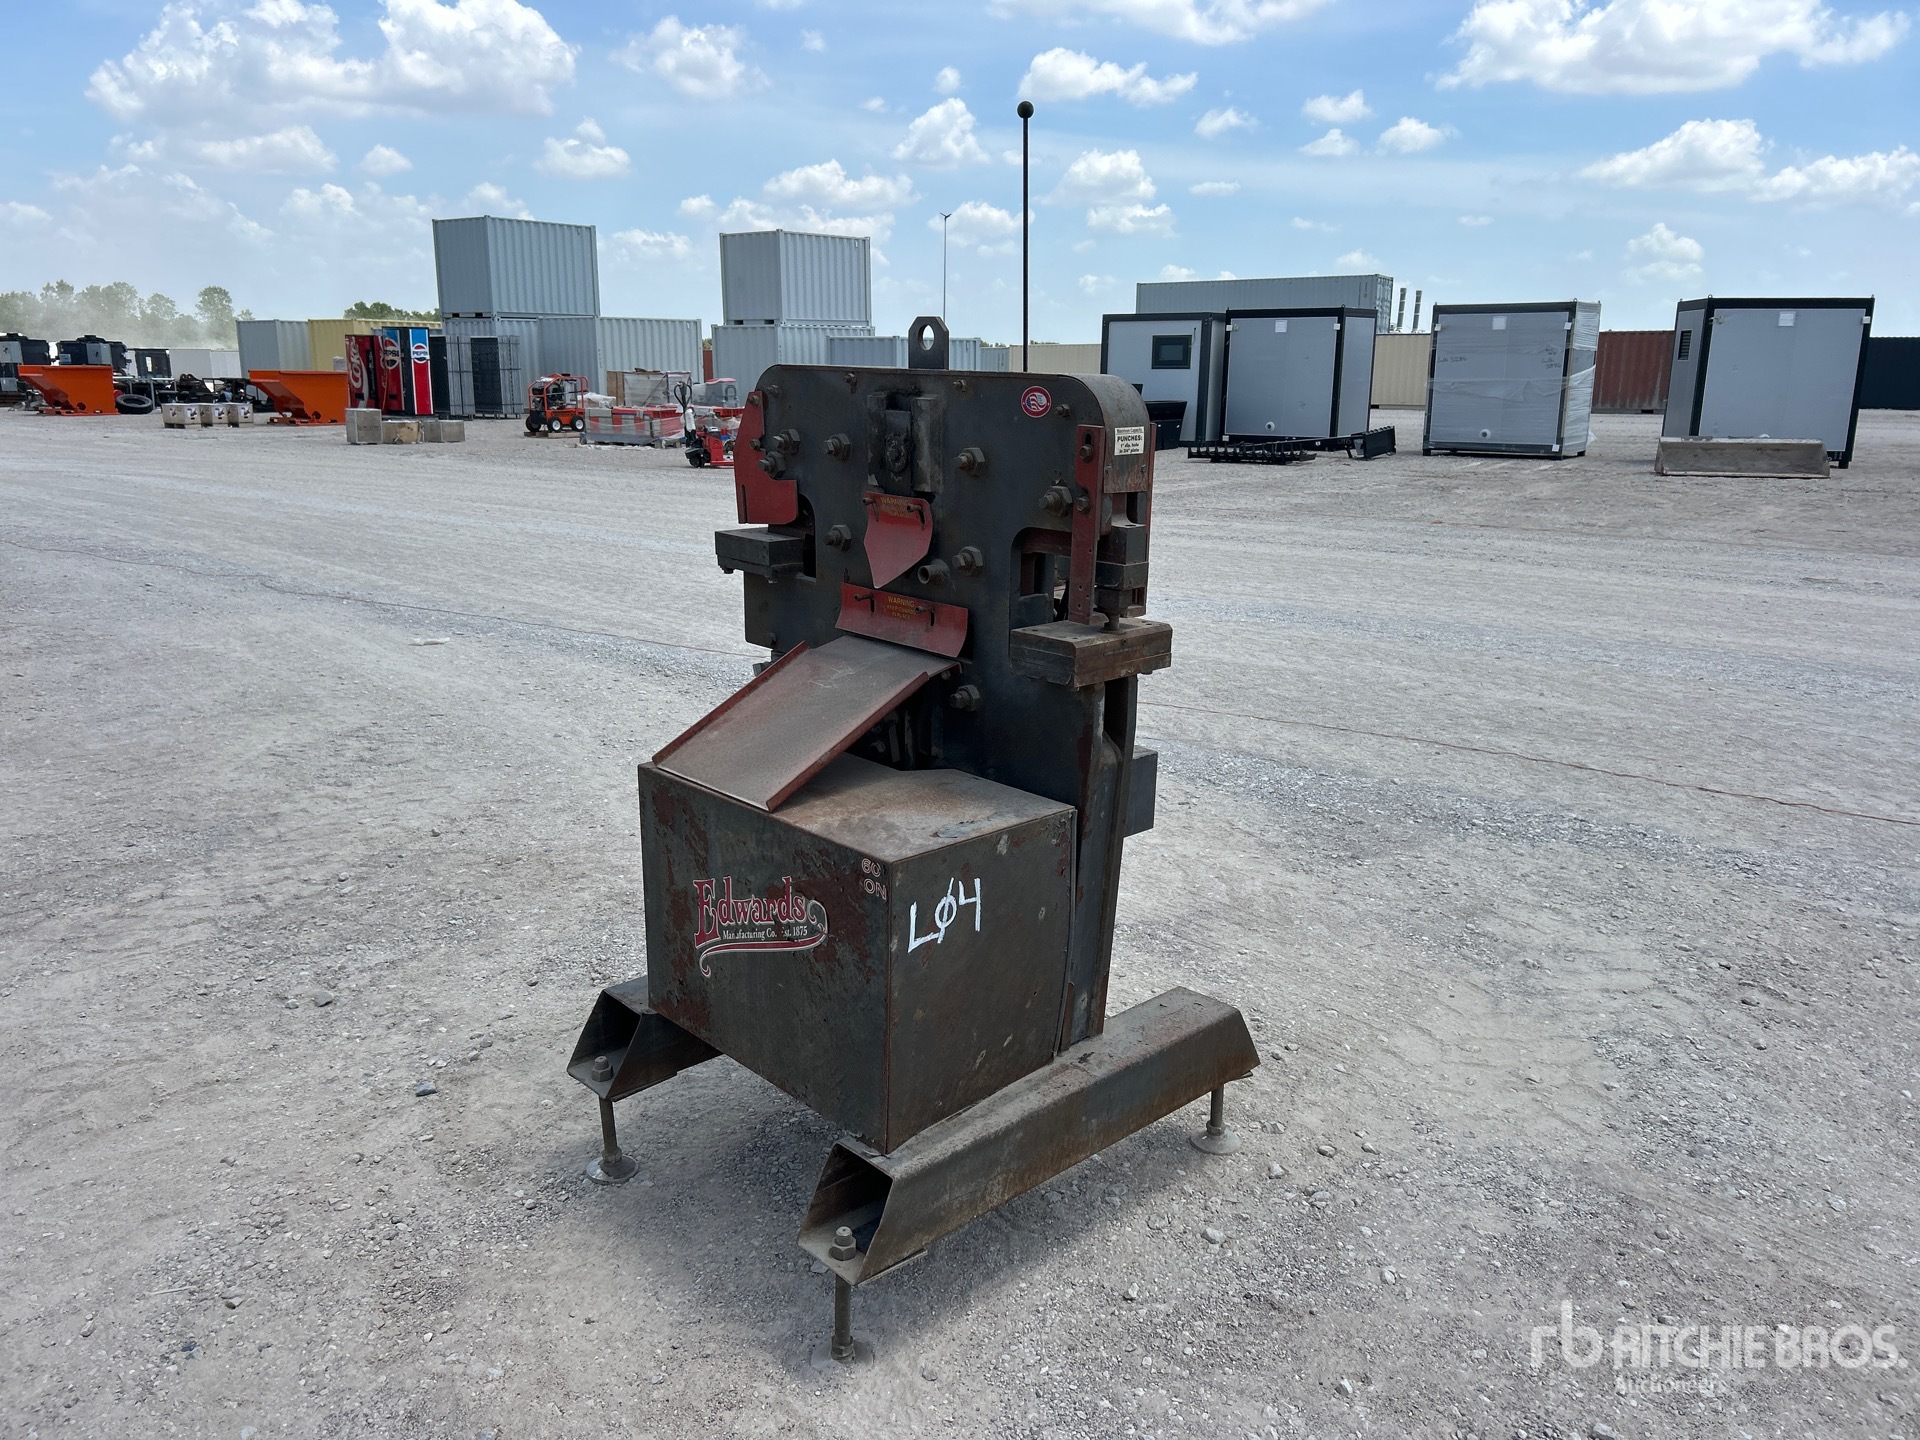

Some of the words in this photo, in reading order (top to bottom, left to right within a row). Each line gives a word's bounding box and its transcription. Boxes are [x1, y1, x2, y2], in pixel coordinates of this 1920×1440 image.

[887, 595, 915, 608] WARNING
[693, 876, 807, 949] Edwards
[766, 928, 778, 938] Co.
[780, 926, 792, 938] st.
[792, 925, 808, 937] 1875
